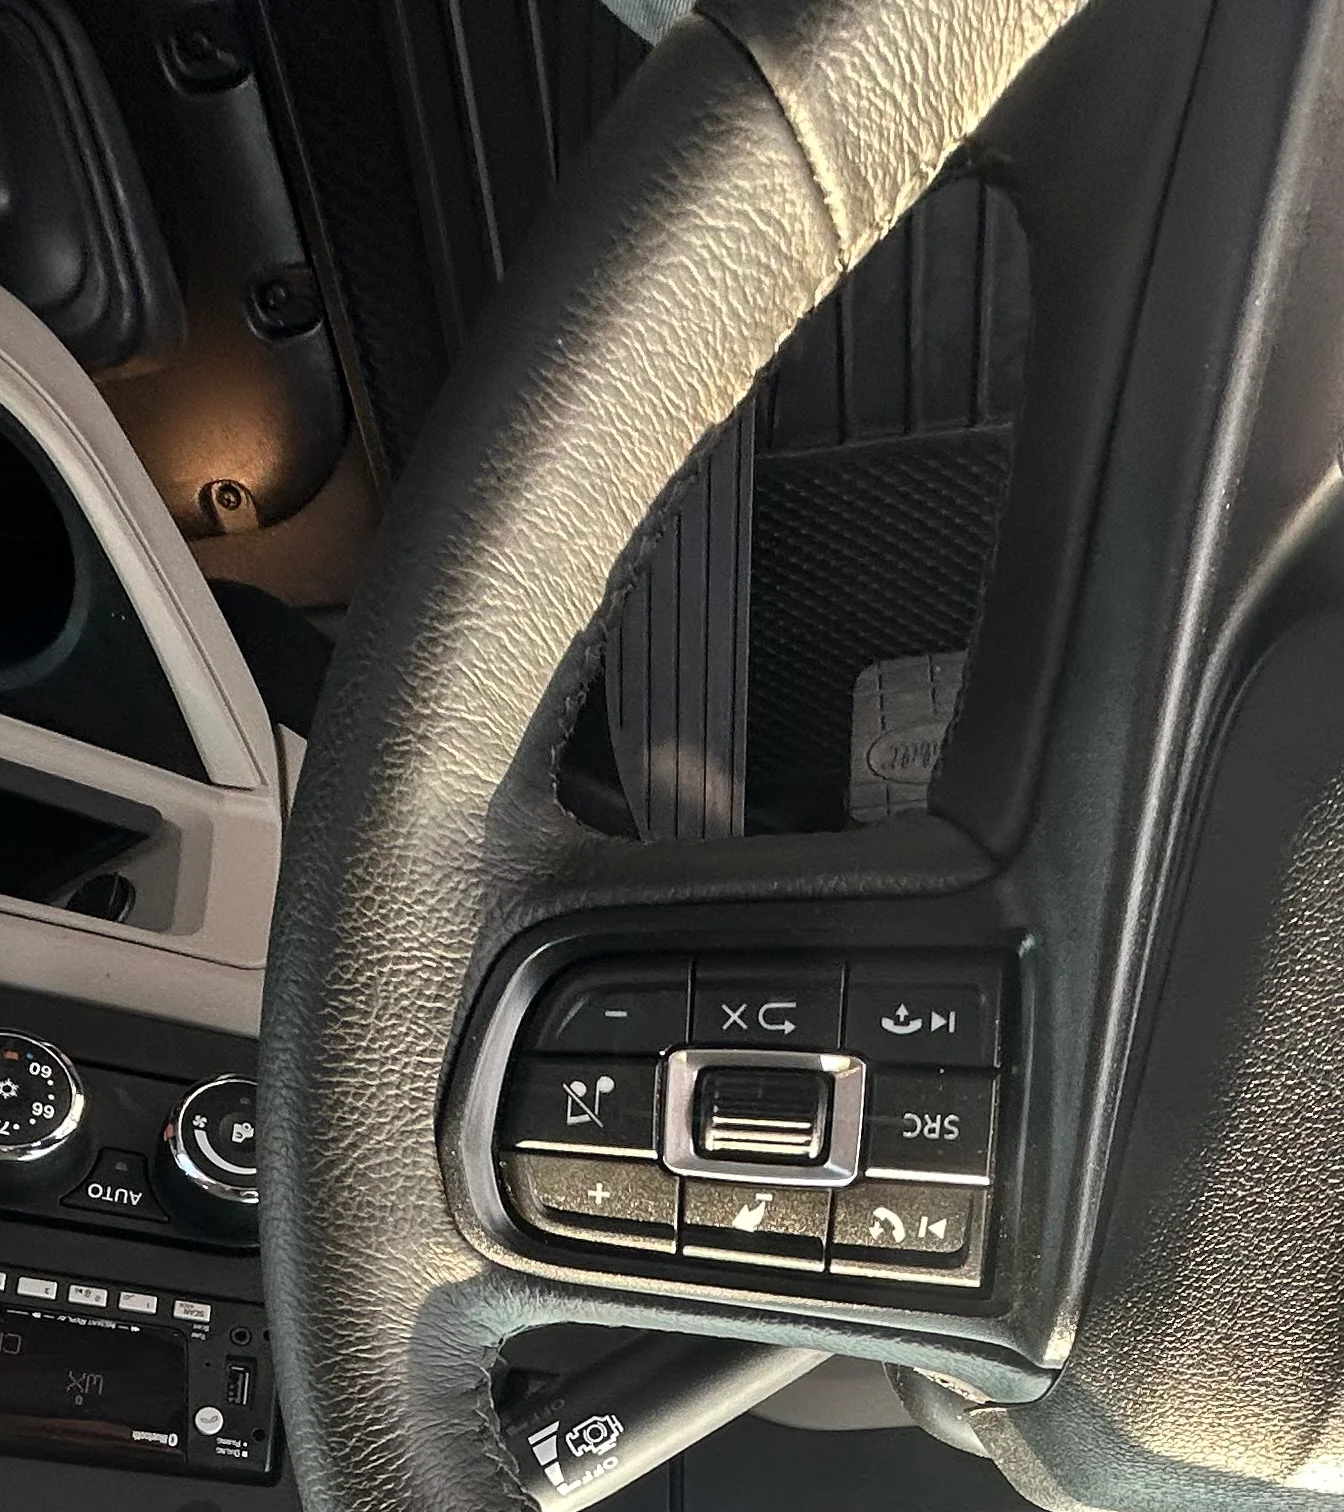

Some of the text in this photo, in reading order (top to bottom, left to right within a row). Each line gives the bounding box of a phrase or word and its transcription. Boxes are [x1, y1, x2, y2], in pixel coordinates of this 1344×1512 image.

[29, 1061, 52, 1079] 60
[31, 1101, 55, 1119] 66
[901, 1112, 960, 1140] SRC
[87, 1182, 143, 1206] AUTO
